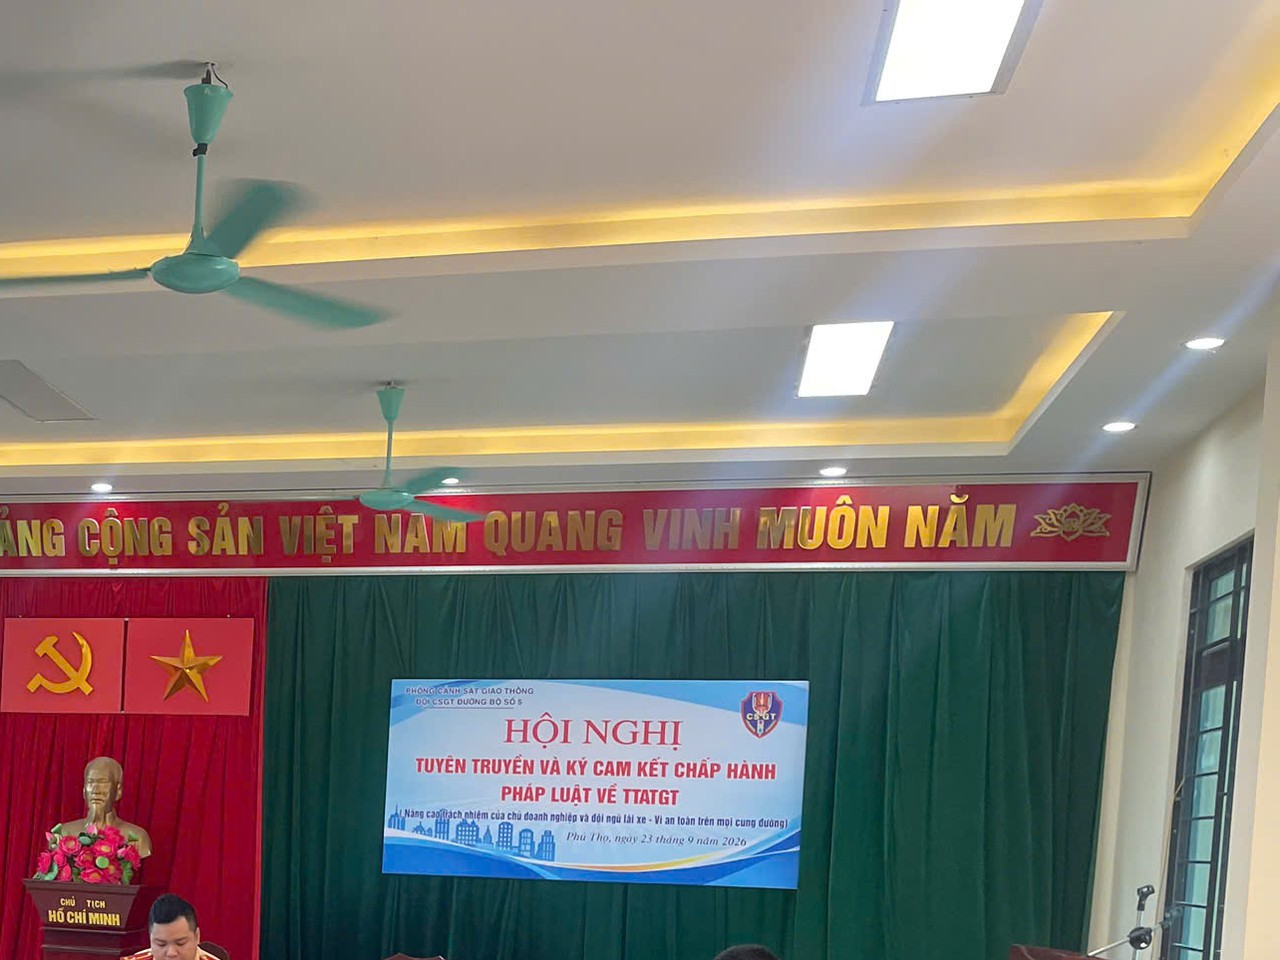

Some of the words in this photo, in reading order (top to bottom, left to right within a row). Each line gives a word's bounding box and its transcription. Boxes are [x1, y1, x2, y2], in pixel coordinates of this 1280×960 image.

[78, 507, 173, 565] CỘNG
[187, 502, 264, 556] SẢN
[279, 505, 359, 563] VIỆT
[374, 513, 467, 554] NAM
[484, 508, 624, 557] QUANG
[642, 507, 740, 551] VINH
[756, 494, 891, 550] MUÔN
[903, 493, 1017, 549] NĂM
[505, 686, 534, 695] THÔNG
[504, 711, 572, 750] HỘI
[583, 719, 683, 751] NGHỊ
[416, 755, 466, 774] TUYÊN
[472, 753, 535, 775] TRUYỀN
[540, 756, 561, 776] VÀ
[566, 756, 588, 776] KÝ
[593, 760, 632, 777] CAM
[637, 756, 669, 778] KẾT
[674, 757, 721, 779] CHẤP
[726, 760, 777, 780] HÀNH
[501, 783, 546, 802] PHÁP
[551, 784, 592, 806] LUẬT
[596, 783, 618, 804] VỀ
[623, 788, 679, 805] TTATGT
[426, 810, 440, 818] cao
[491, 809, 505, 820] của
[524, 811, 548, 821] doanh
[550, 812, 577, 824] nghiệp
[580, 812, 589, 823] và
[591, 813, 604, 823] đội
[636, 816, 646, 824] xe
[665, 817, 675, 825] an
[698, 816, 715, 827] trên
[716, 817, 733, 829] mọi
[735, 819, 756, 829] cung
[566, 831, 587, 841] Phú
[614, 834, 638, 844] ngày
[641, 834, 653, 844] 23
[656, 835, 685, 846] tháng
[696, 836, 719, 846] năm
[722, 837, 747, 847] 2026
[60, 896, 76, 906] CHỦ
[86, 899, 106, 909] TỊCH
[48, 906, 64, 923] HỒ
[66, 909, 87, 924] CHÍ
[89, 912, 121, 926] MINH
